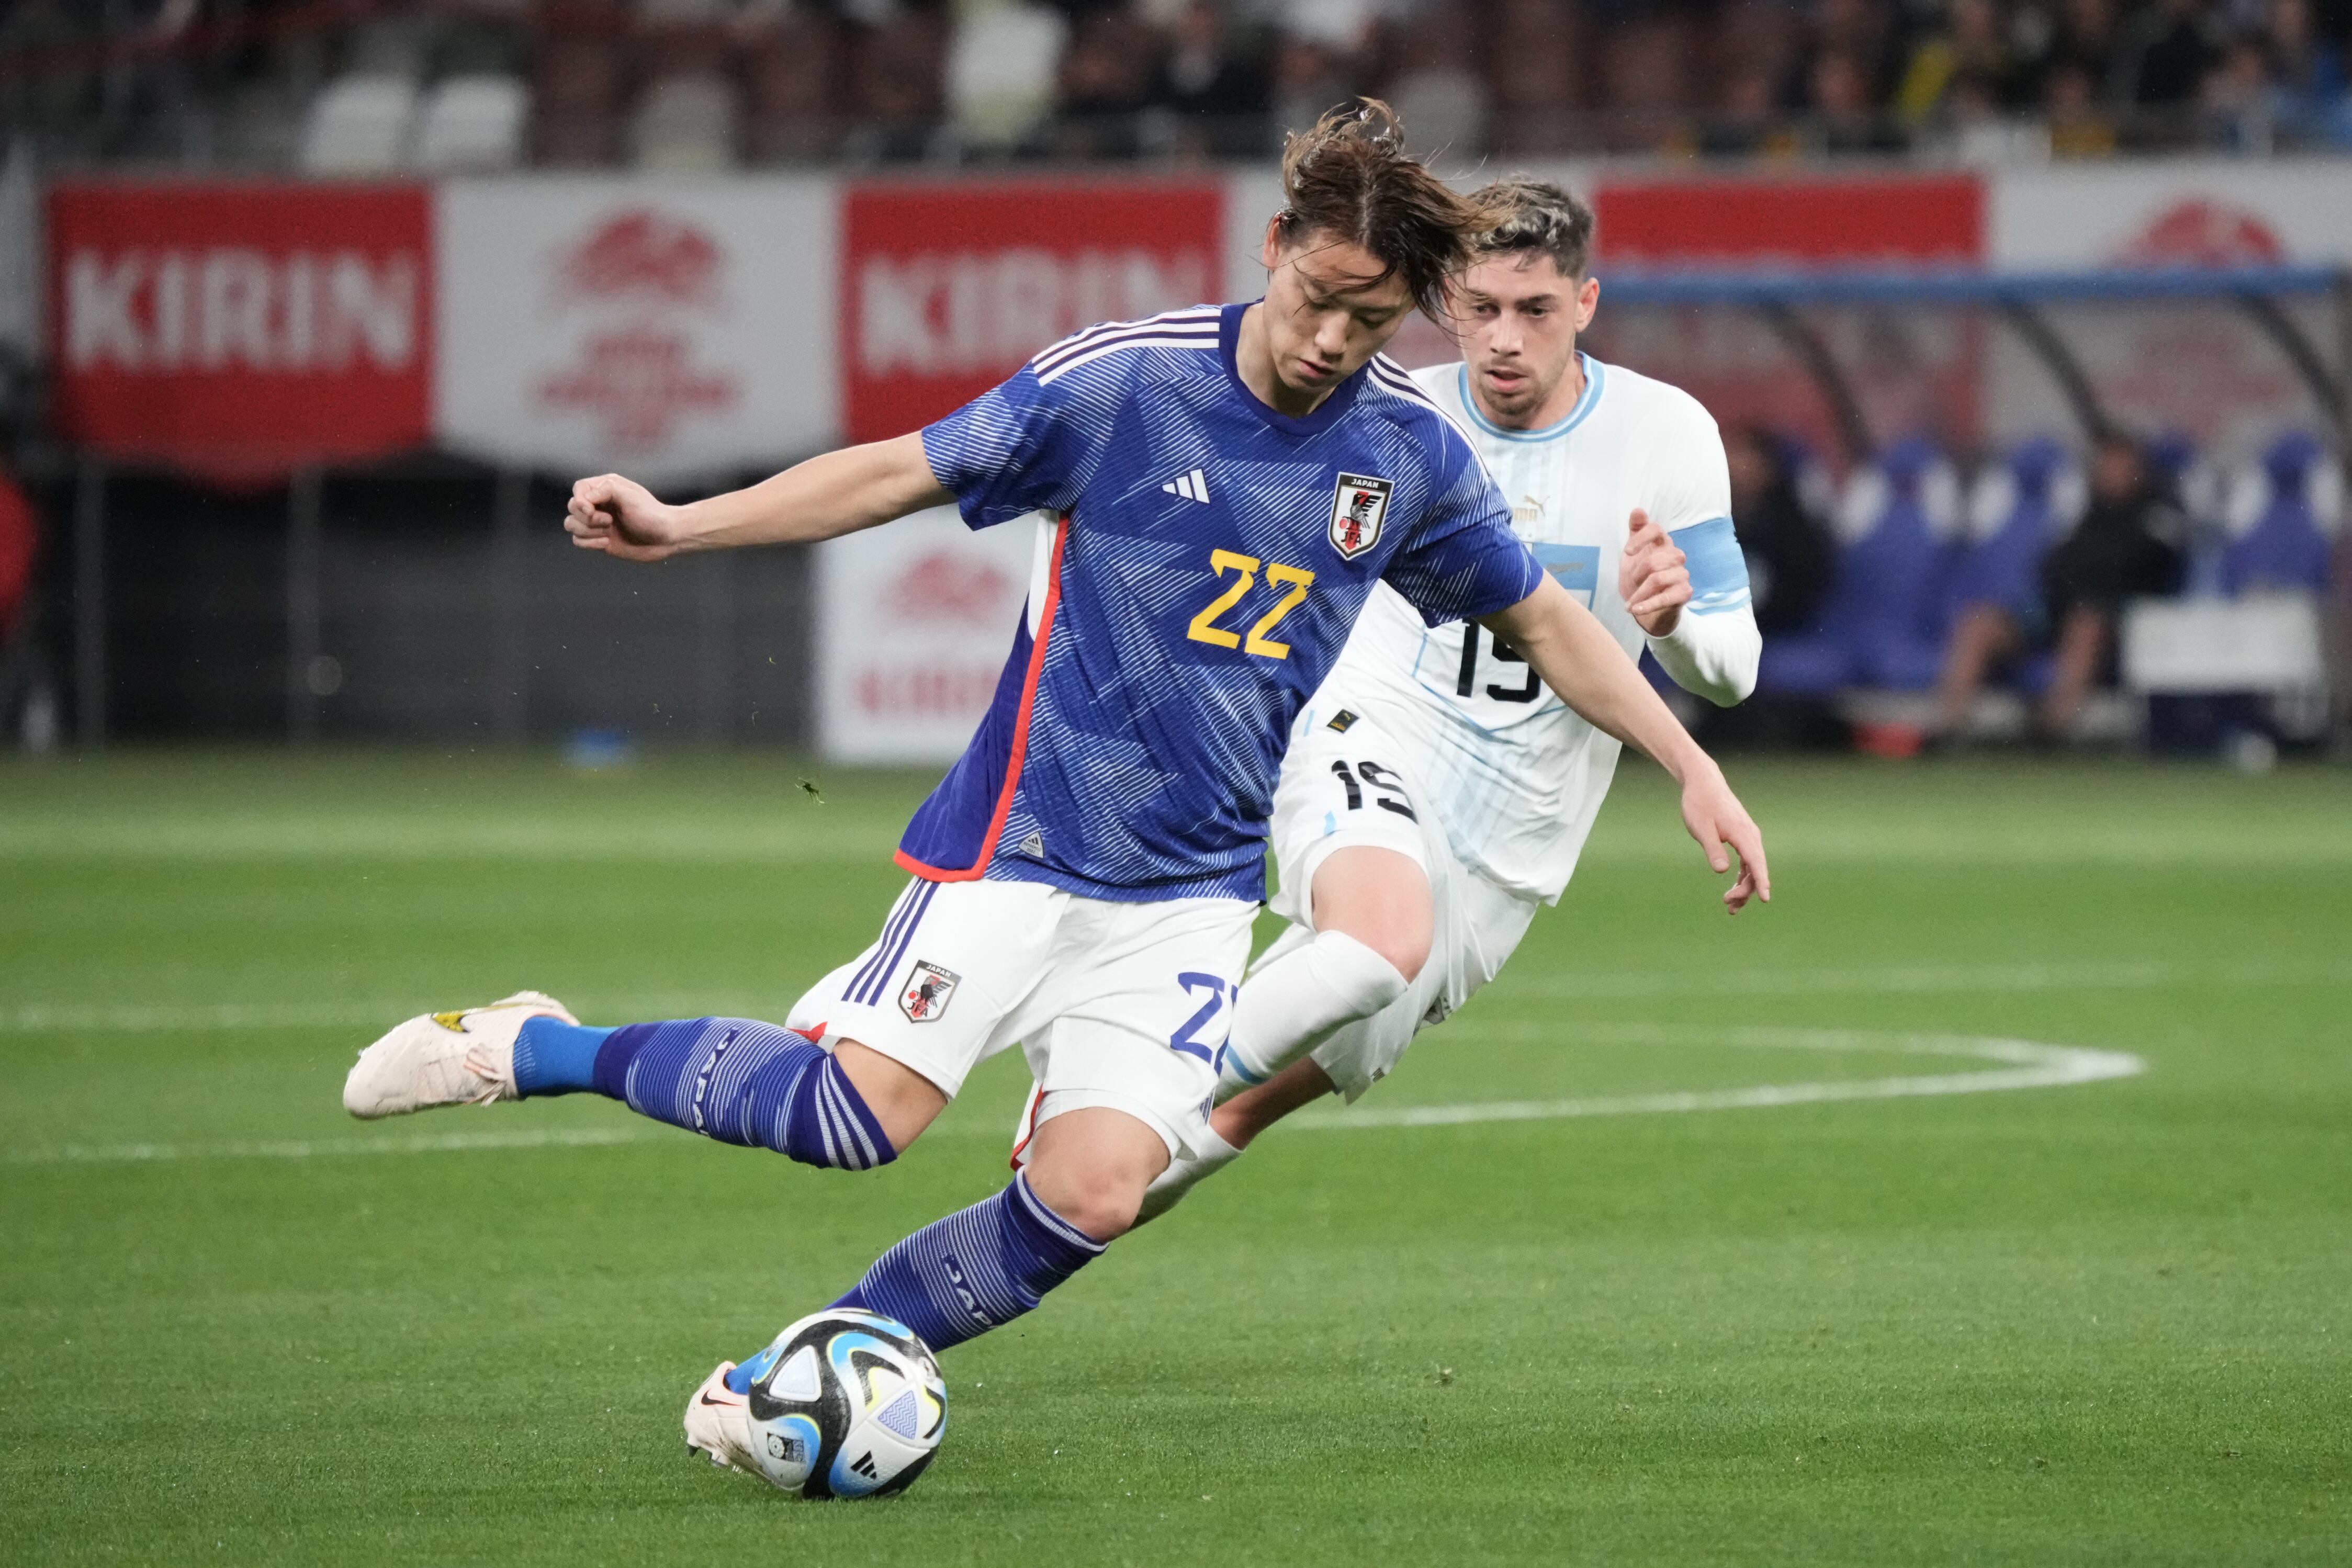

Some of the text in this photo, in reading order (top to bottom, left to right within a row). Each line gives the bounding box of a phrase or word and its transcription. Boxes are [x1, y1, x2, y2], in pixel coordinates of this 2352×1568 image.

[64, 246, 418, 370] KIRIN
[1351, 478, 1379, 489] JAPAN
[1340, 531, 1362, 545] JFA
[1187, 548, 1315, 660] 22
[1331, 760, 1420, 826] 15
[926, 964, 952, 977] JAPAN
[693, 1031, 731, 1137] JAPA
[945, 1262, 998, 1329] JAP
